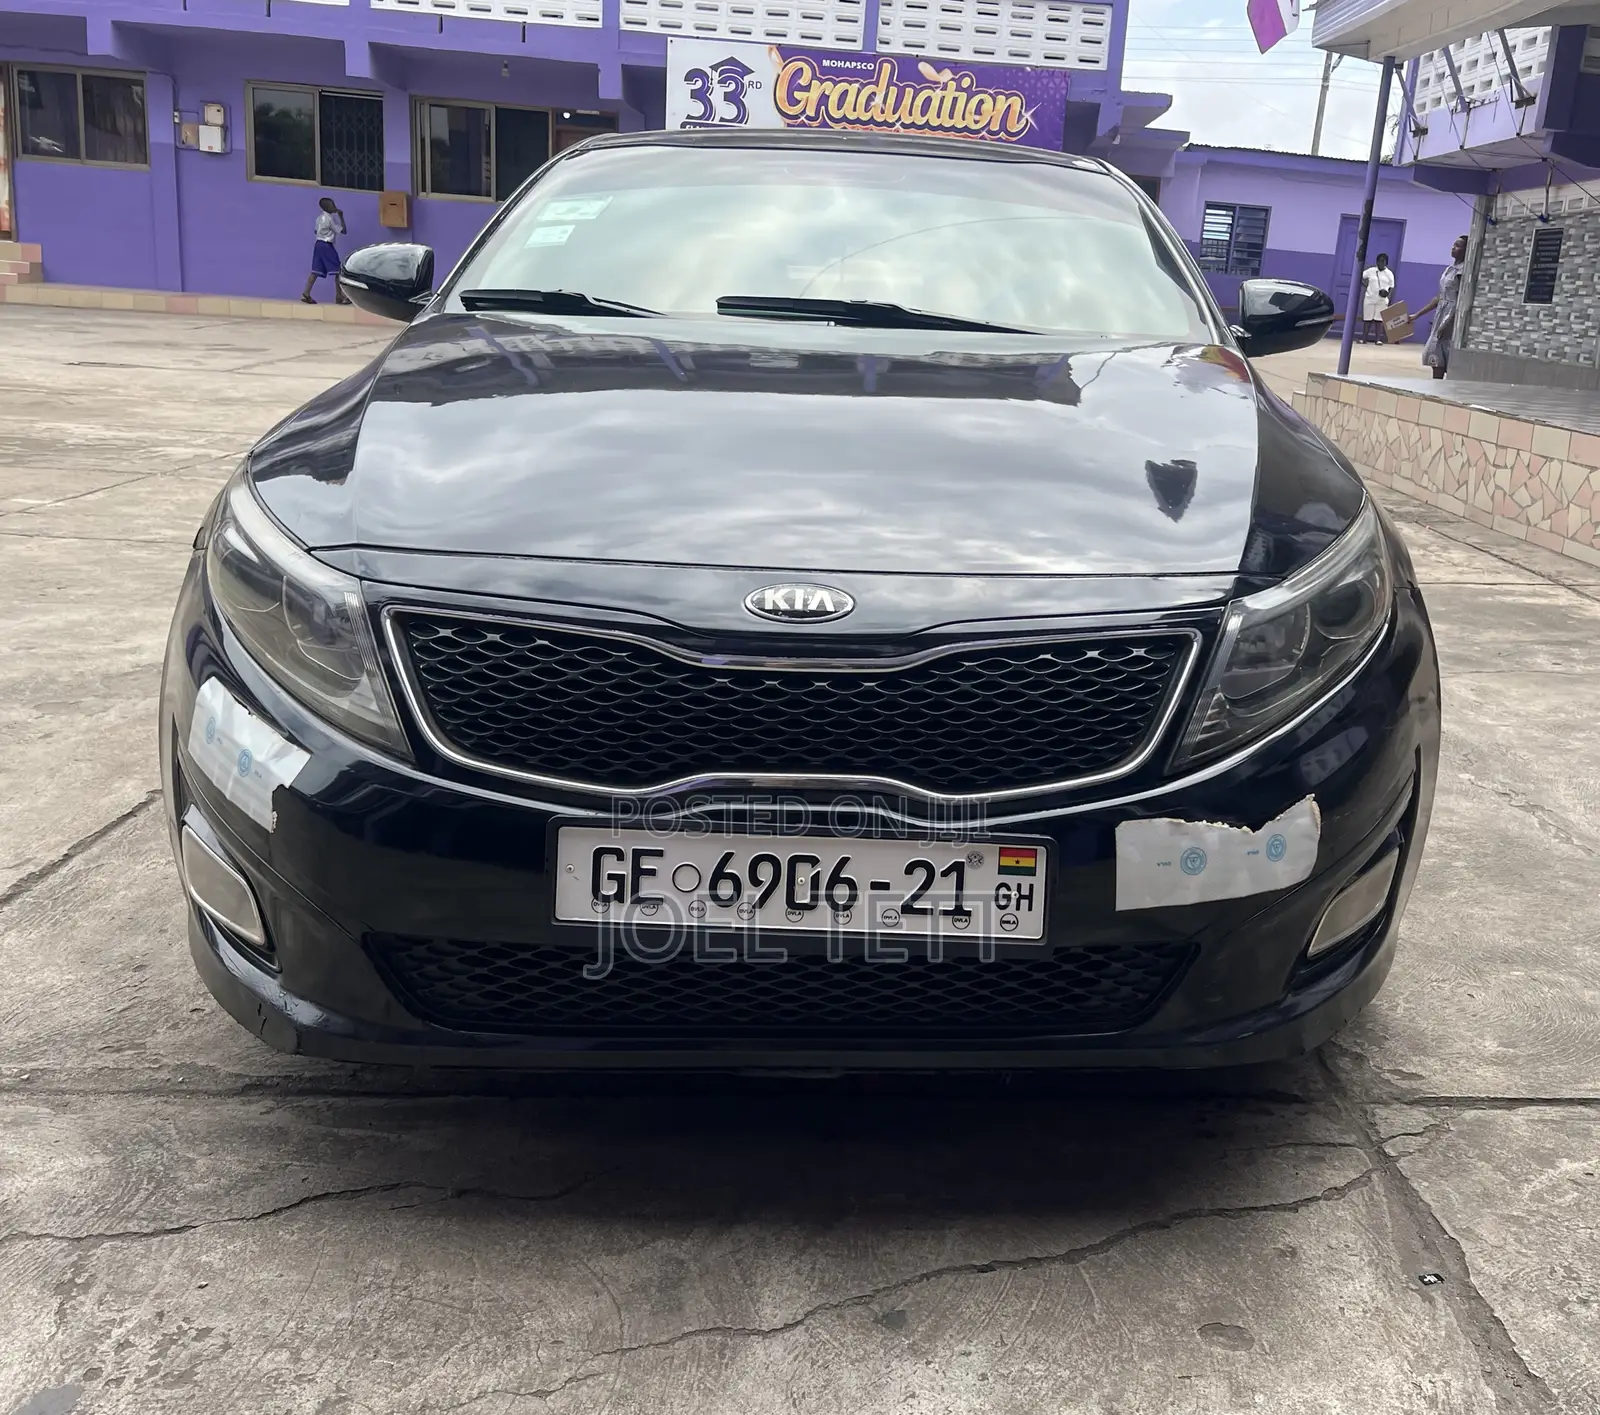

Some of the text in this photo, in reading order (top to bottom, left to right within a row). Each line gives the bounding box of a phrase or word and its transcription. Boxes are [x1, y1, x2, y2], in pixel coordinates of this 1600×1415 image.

[822, 59, 875, 70] MOHAPSCO
[776, 60, 1030, 134] Graduation
[764, 588, 836, 613] KIA
[591, 846, 664, 904] GE
[994, 882, 1035, 912] GH
